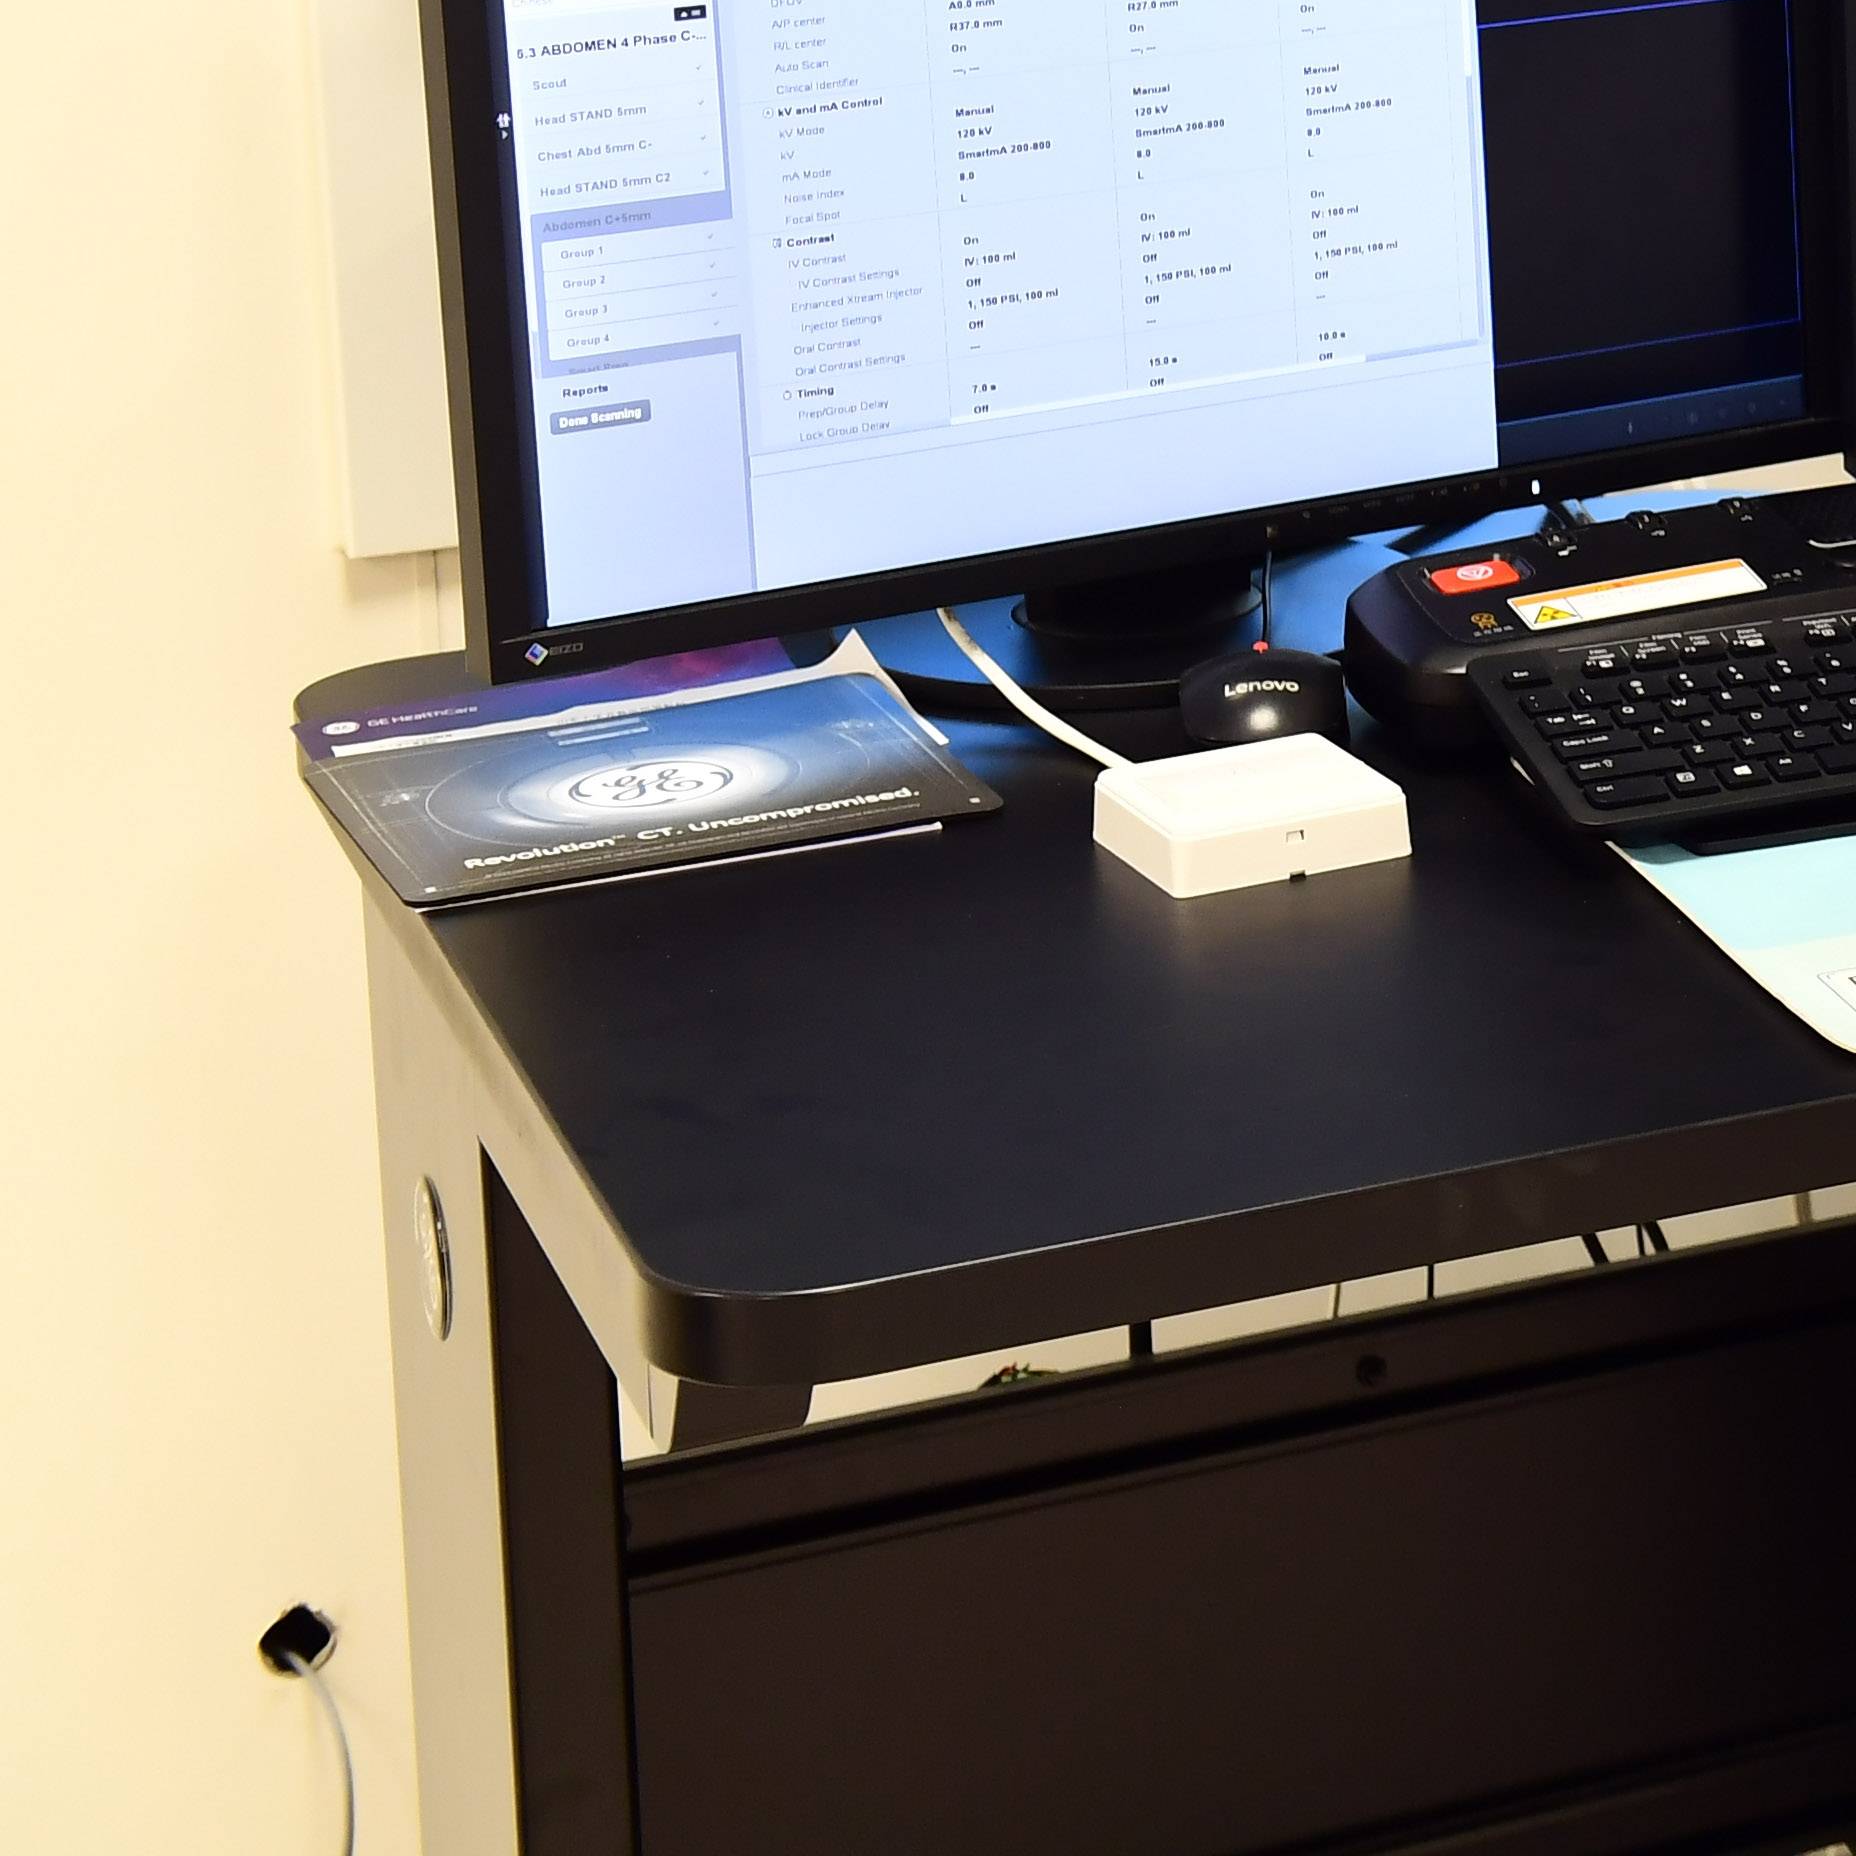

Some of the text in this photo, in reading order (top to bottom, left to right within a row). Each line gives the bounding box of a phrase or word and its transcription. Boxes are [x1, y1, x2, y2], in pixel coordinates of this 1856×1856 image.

[793, 15, 826, 27] center
[540, 39, 617, 57] ABDOMEN
[621, 38, 629, 49] 4
[633, 34, 677, 47] Phase
[951, 43, 967, 53] On
[801, 60, 829, 71] Scan
[533, 78, 567, 91] Scout
[776, 77, 859, 95] Clinical Identifier
[778, 97, 883, 118] kV and mA Control
[955, 105, 995, 118] Manual
[535, 105, 647, 127] Head STAND 5mm
[797, 126, 825, 136] Mode
[957, 126, 993, 139] 120 kV
[537, 149, 572, 162] Chest
[576, 145, 602, 158] Abd
[605, 142, 635, 154] 5mm
[540, 172, 671, 197] Head STAND 5mm C2
[785, 211, 841, 225] Focal Spot
[543, 217, 601, 234] Abdomen
[787, 234, 835, 248] Contrast
[560, 246, 604, 260] Group 1
[562, 275, 606, 290] Group 2
[966, 277, 982, 288] Off
[565, 305, 608, 319] Group 3
[566, 333, 610, 348] Group 4
[562, 384, 609, 399] Reports
[797, 386, 835, 399] Timing
[559, 407, 642, 429] Done Scanning
[1224, 680, 1300, 698] Lenovo
[1670, 697, 1687, 707] W
[391, 705, 479, 724] HealthCare
[1653, 726, 1665, 734] A
[1841, 722, 1853, 731] V
[1562, 735, 1609, 747] Caps Lock
[1742, 737, 1755, 746] X
[1692, 744, 1705, 754] Z
[1579, 761, 1601, 770] Shift
[1596, 784, 1614, 792] Ctrl
[636, 824, 685, 842] CT.
[687, 786, 921, 833] Uncompromised.
